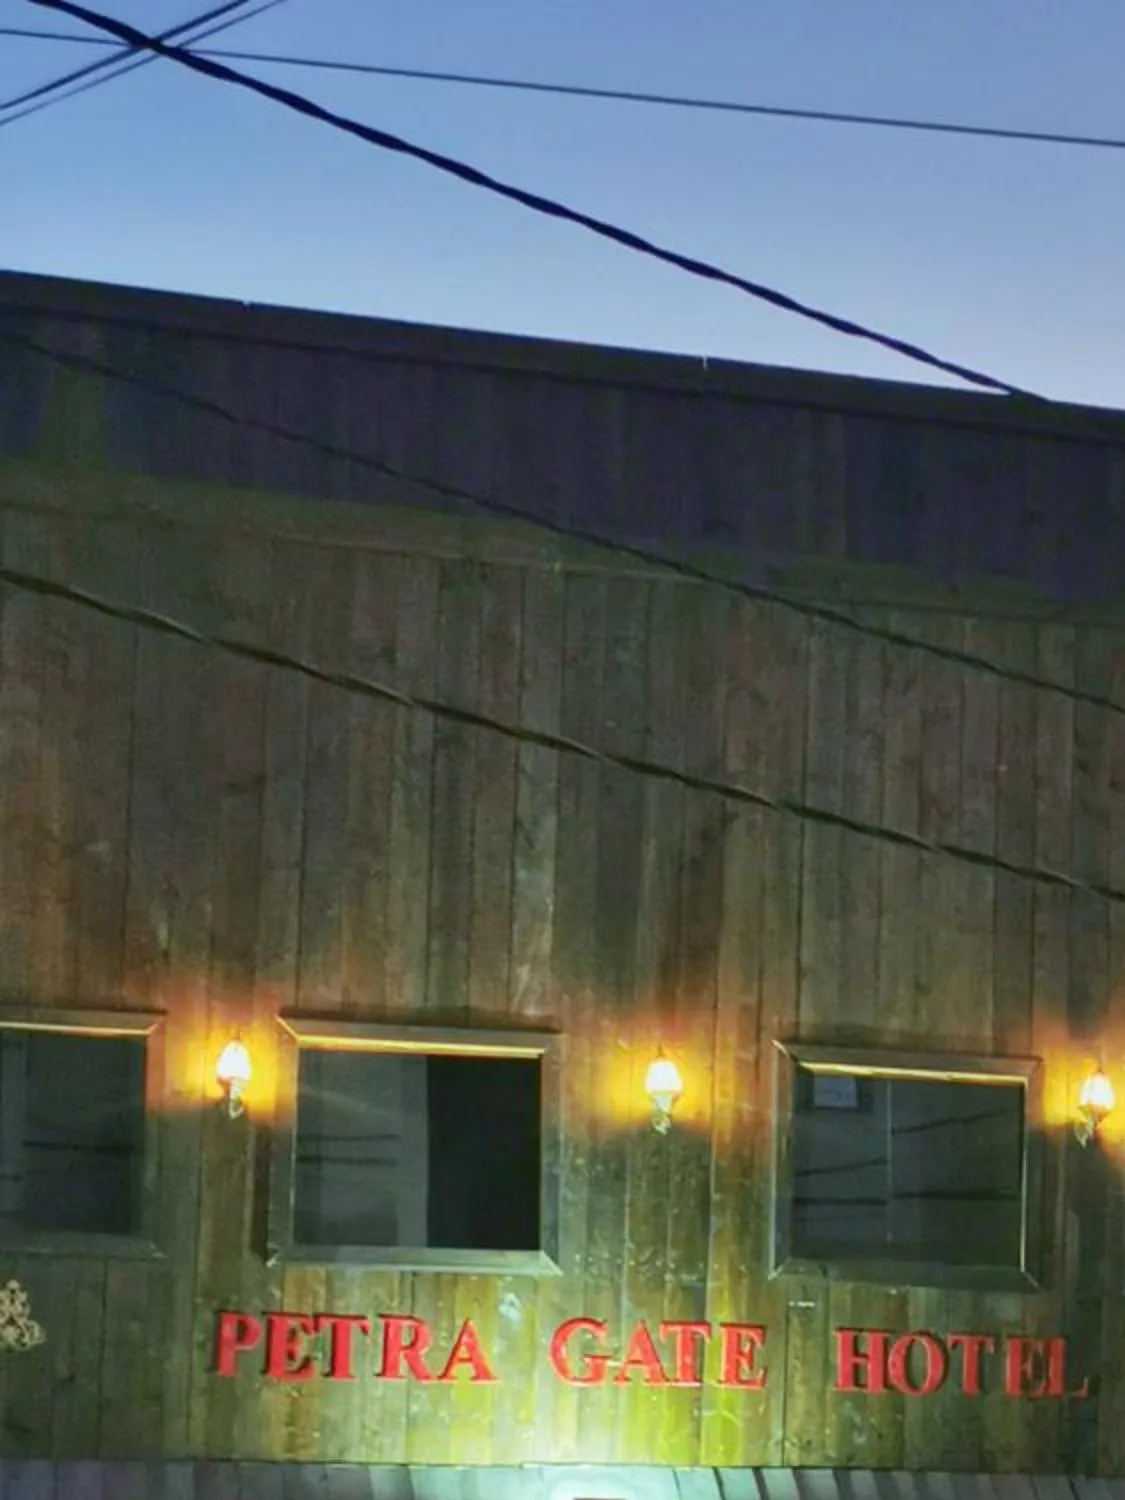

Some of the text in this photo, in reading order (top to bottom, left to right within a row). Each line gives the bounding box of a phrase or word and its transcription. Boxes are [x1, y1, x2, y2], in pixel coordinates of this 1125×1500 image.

[214, 1309, 1090, 1398] PETRA GATE HOTEL
